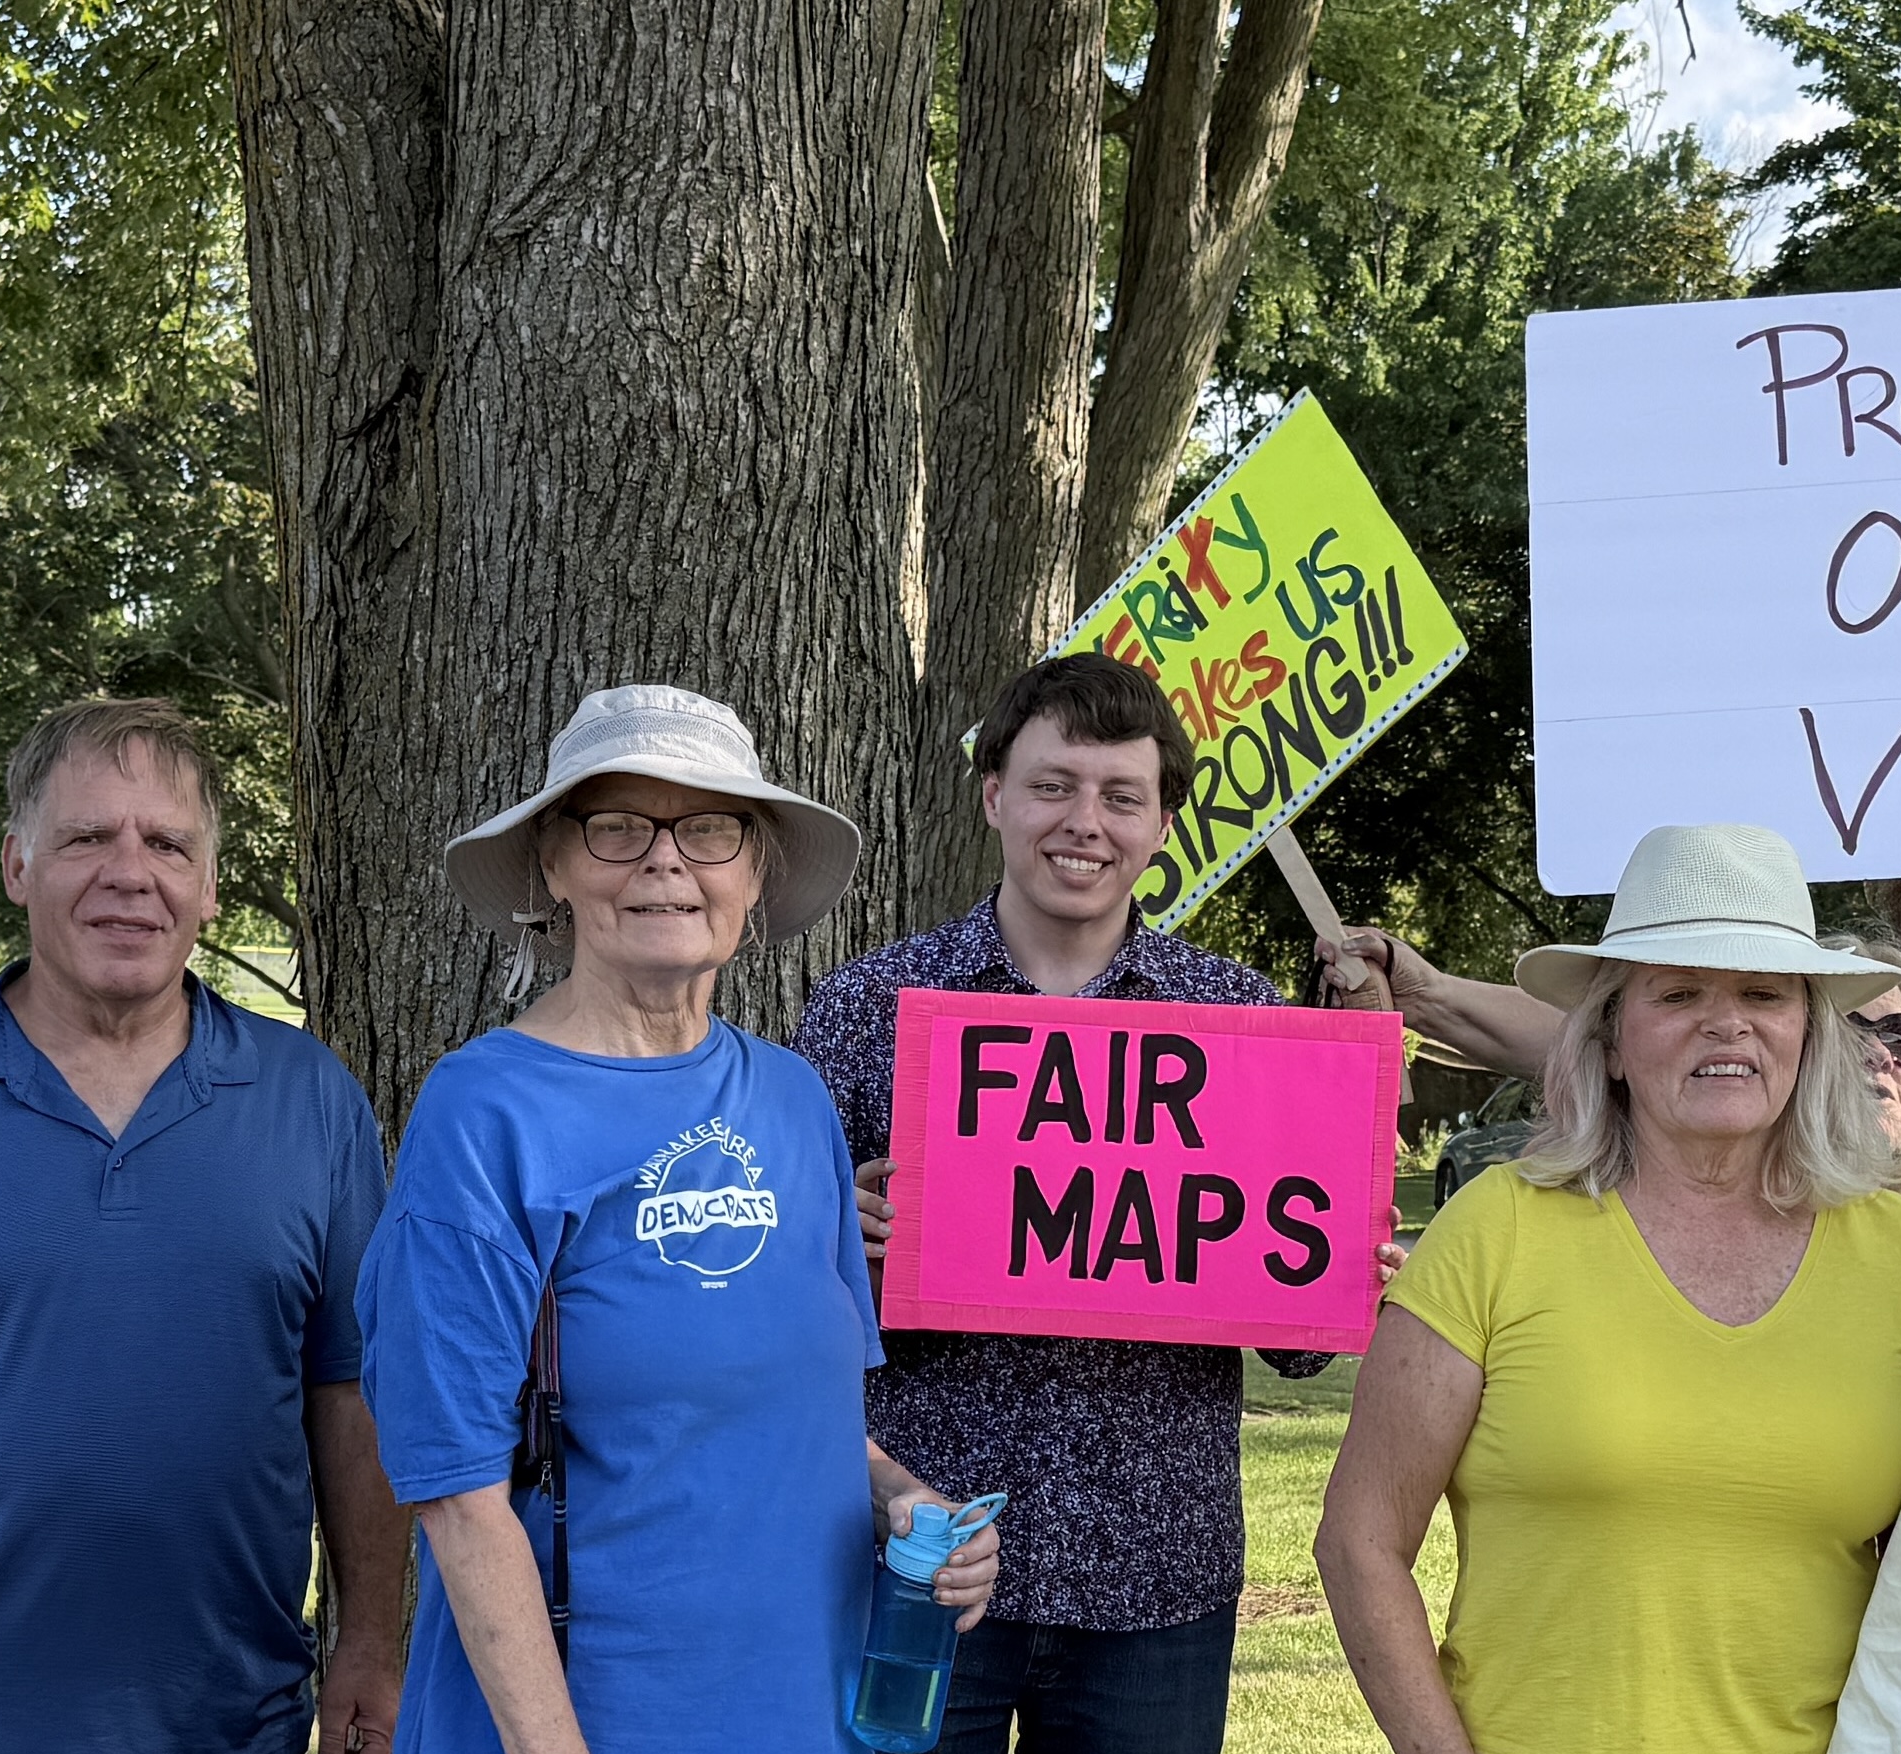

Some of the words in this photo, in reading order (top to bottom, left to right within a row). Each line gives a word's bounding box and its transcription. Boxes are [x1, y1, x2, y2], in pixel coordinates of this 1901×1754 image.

[1167, 630, 1287, 751] akes
[1275, 527, 1365, 641] US
[956, 1024, 1208, 1150] FAIR
[1006, 1165, 1333, 1288] MAPS
